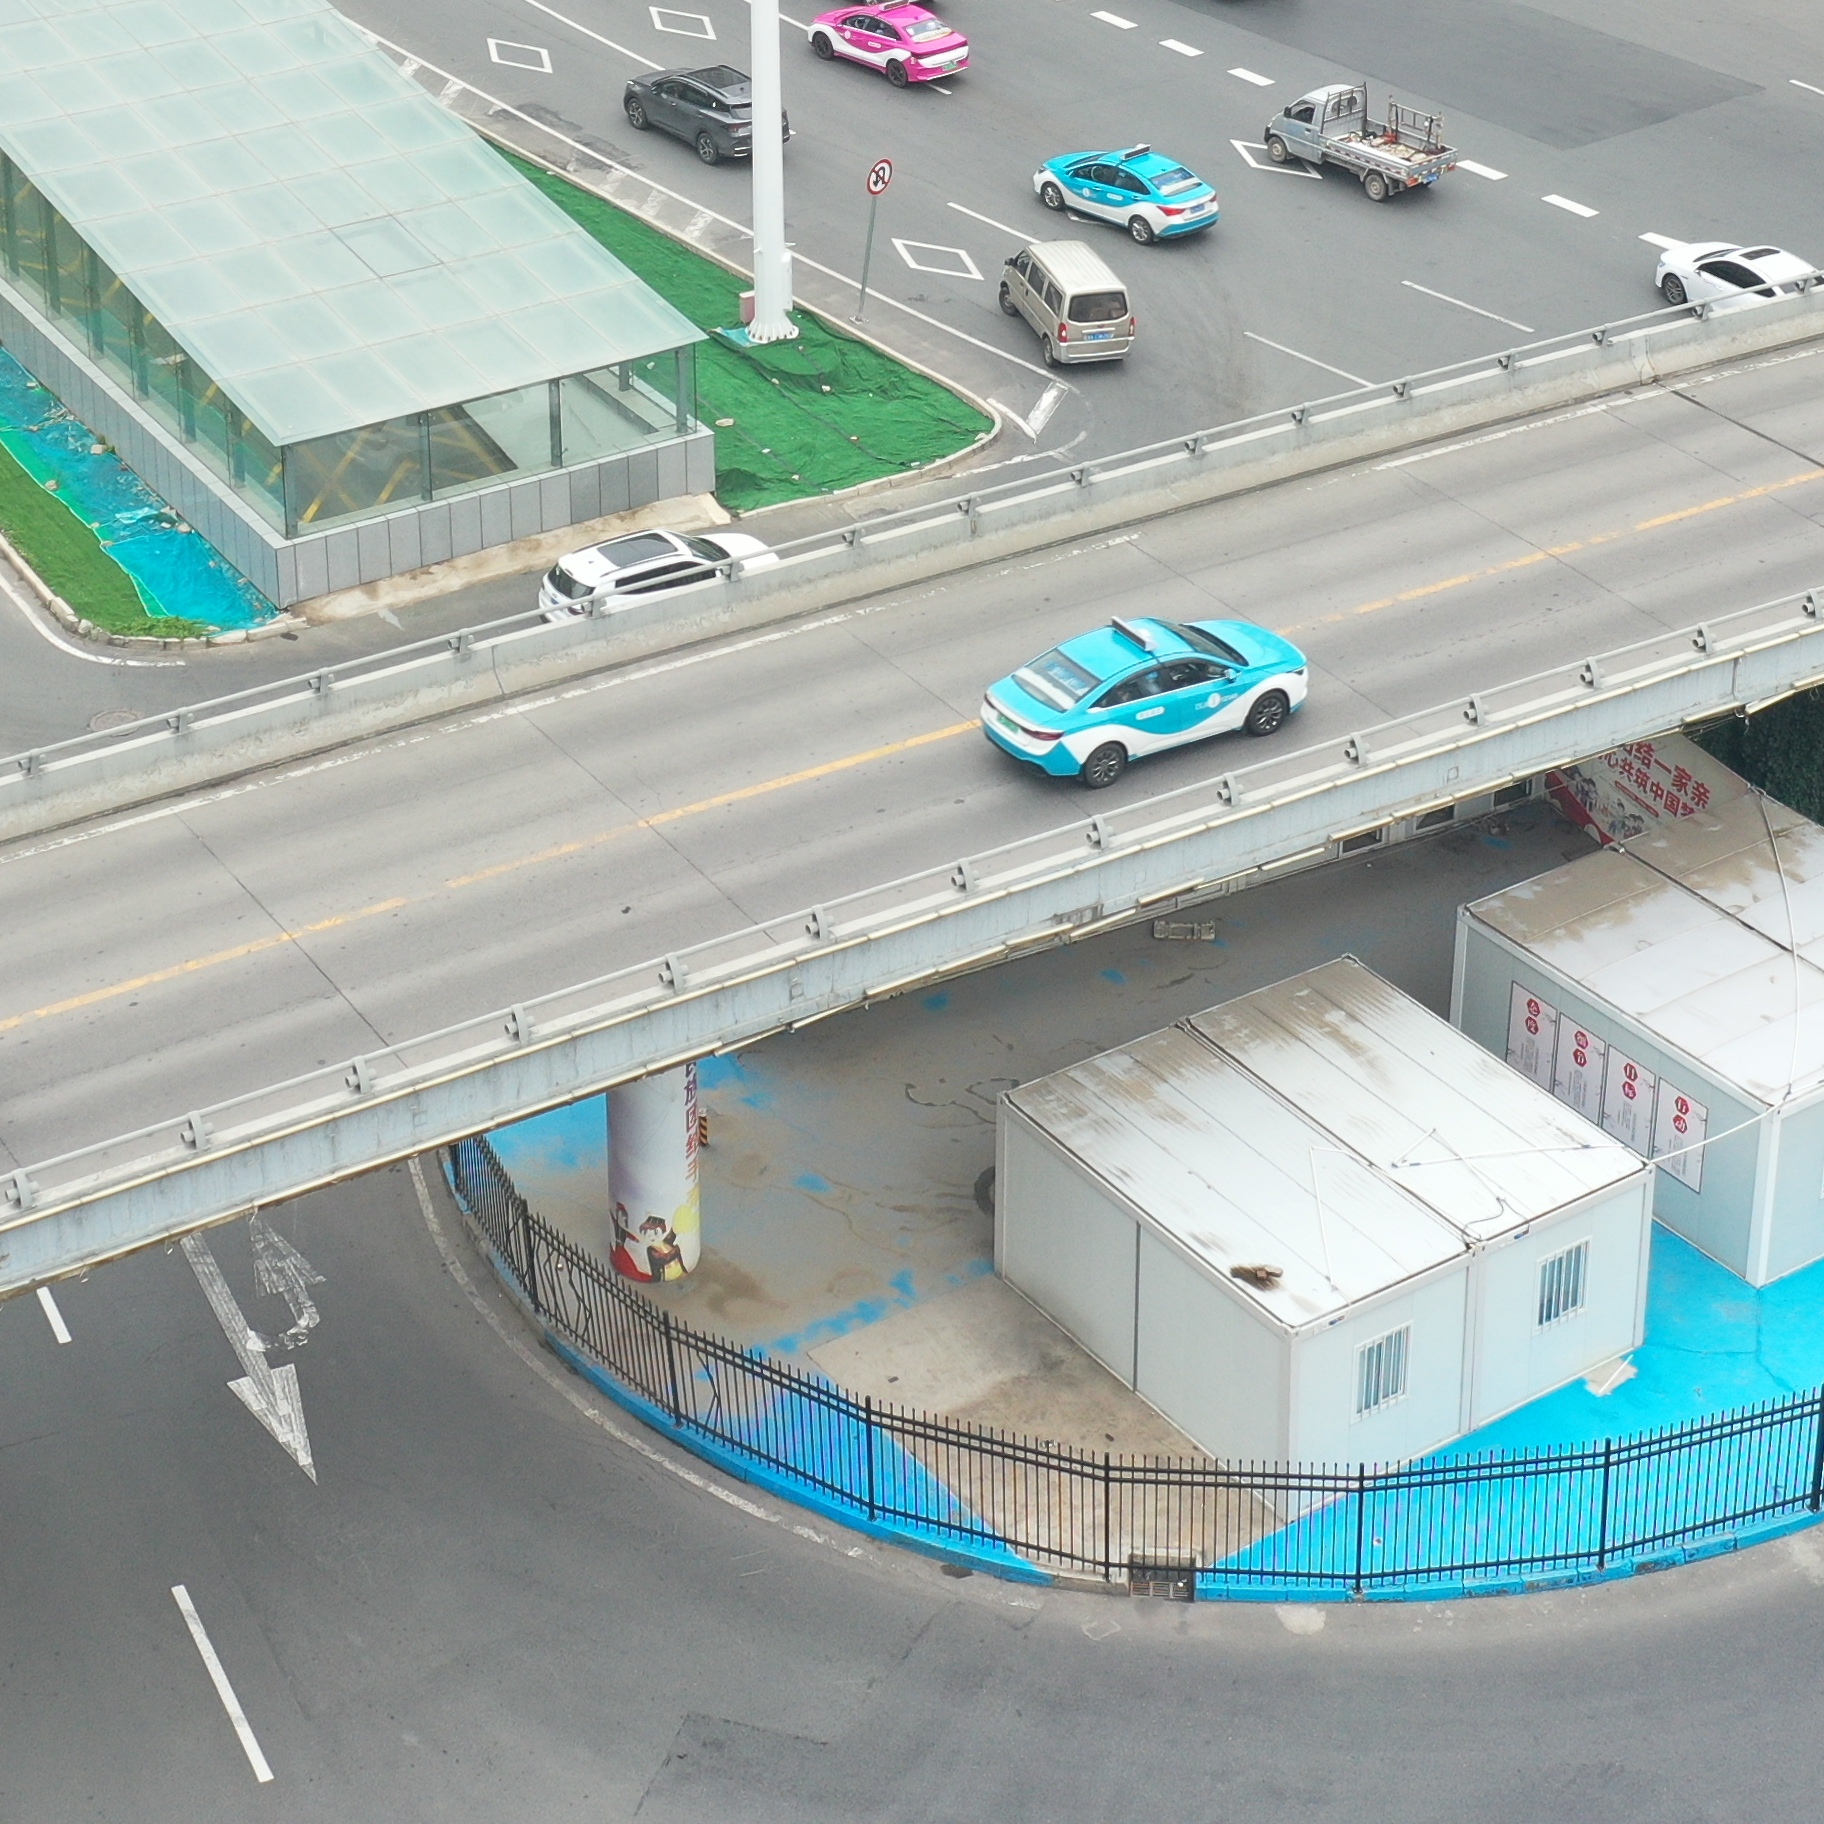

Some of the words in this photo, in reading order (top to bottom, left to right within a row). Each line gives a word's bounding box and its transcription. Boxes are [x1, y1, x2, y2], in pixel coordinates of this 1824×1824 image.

[1599, 750, 1697, 818] 心共筑中国
